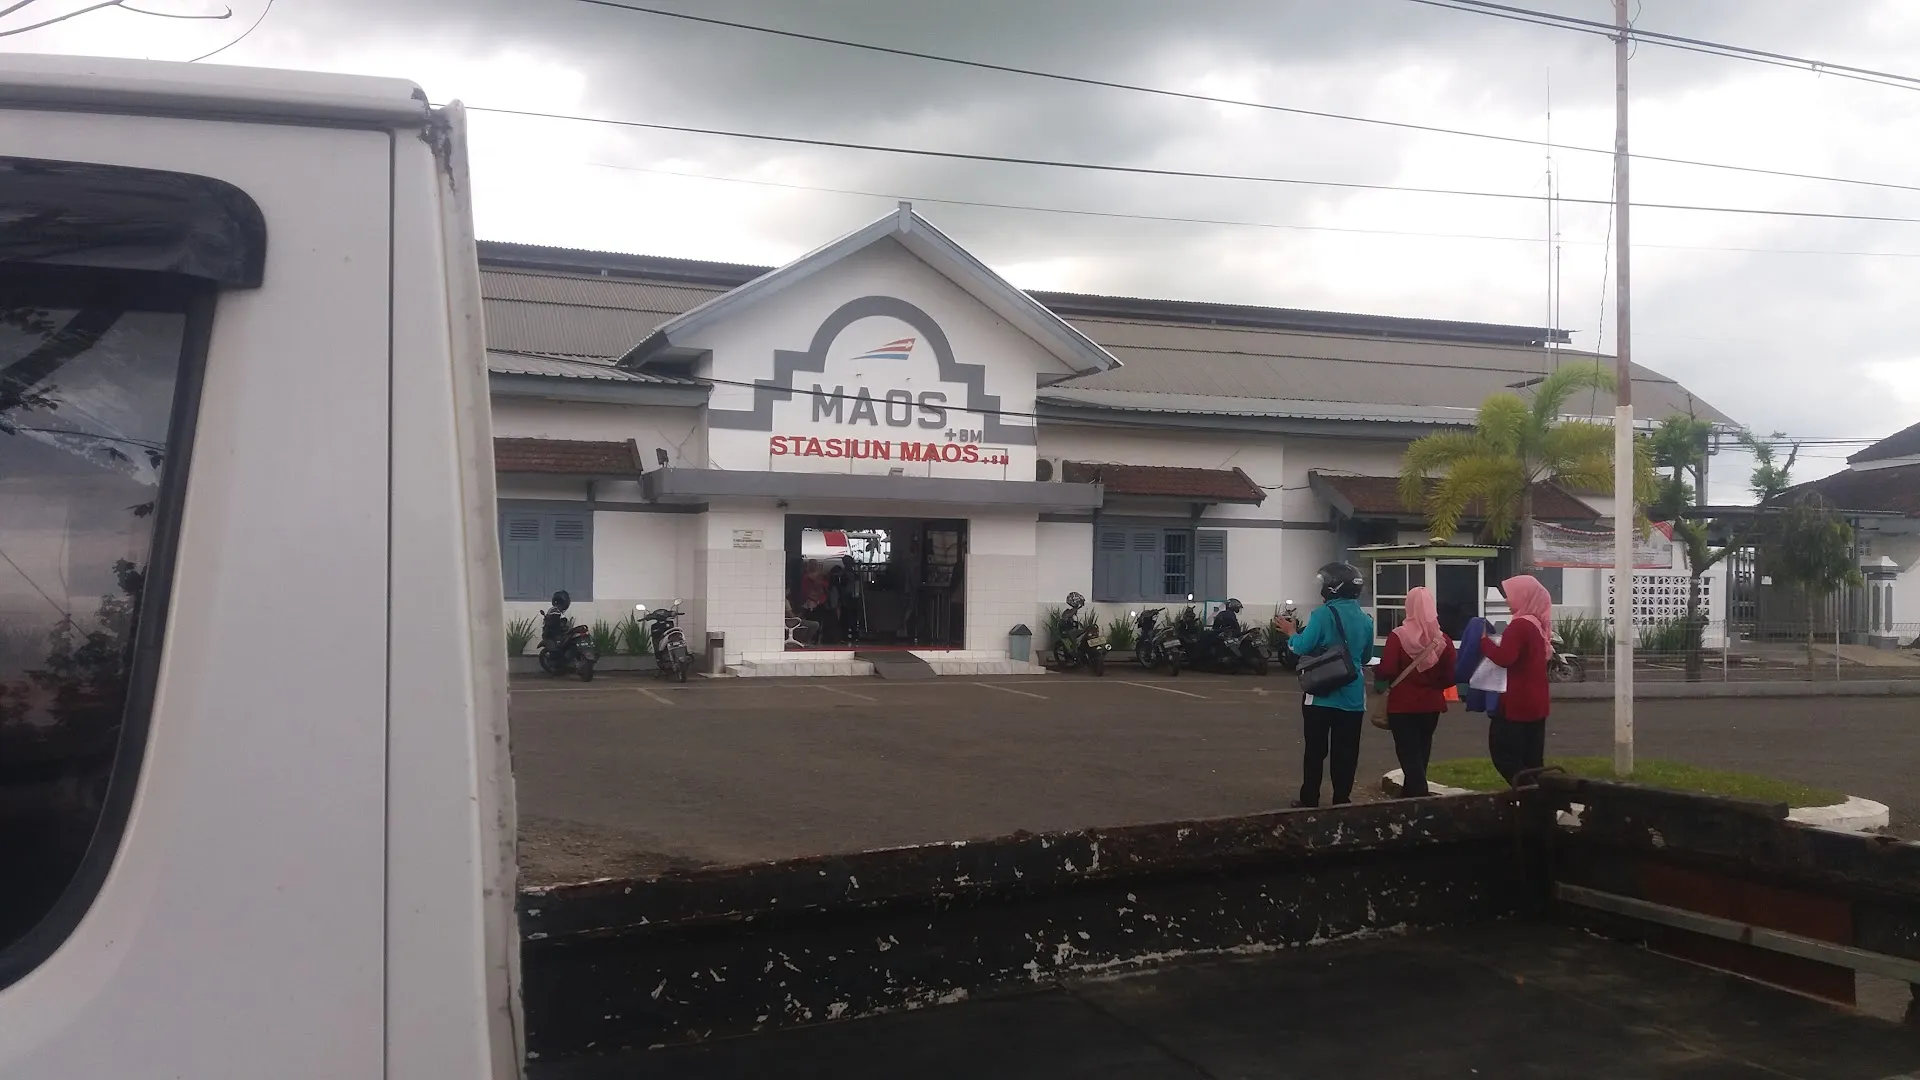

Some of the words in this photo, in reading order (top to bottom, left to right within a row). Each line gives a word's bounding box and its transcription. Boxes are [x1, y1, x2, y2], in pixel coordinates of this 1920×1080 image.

[812, 384, 947, 429] MAOS
[771, 436, 890, 460] STASIUN
[900, 442, 979, 463] MAOS
